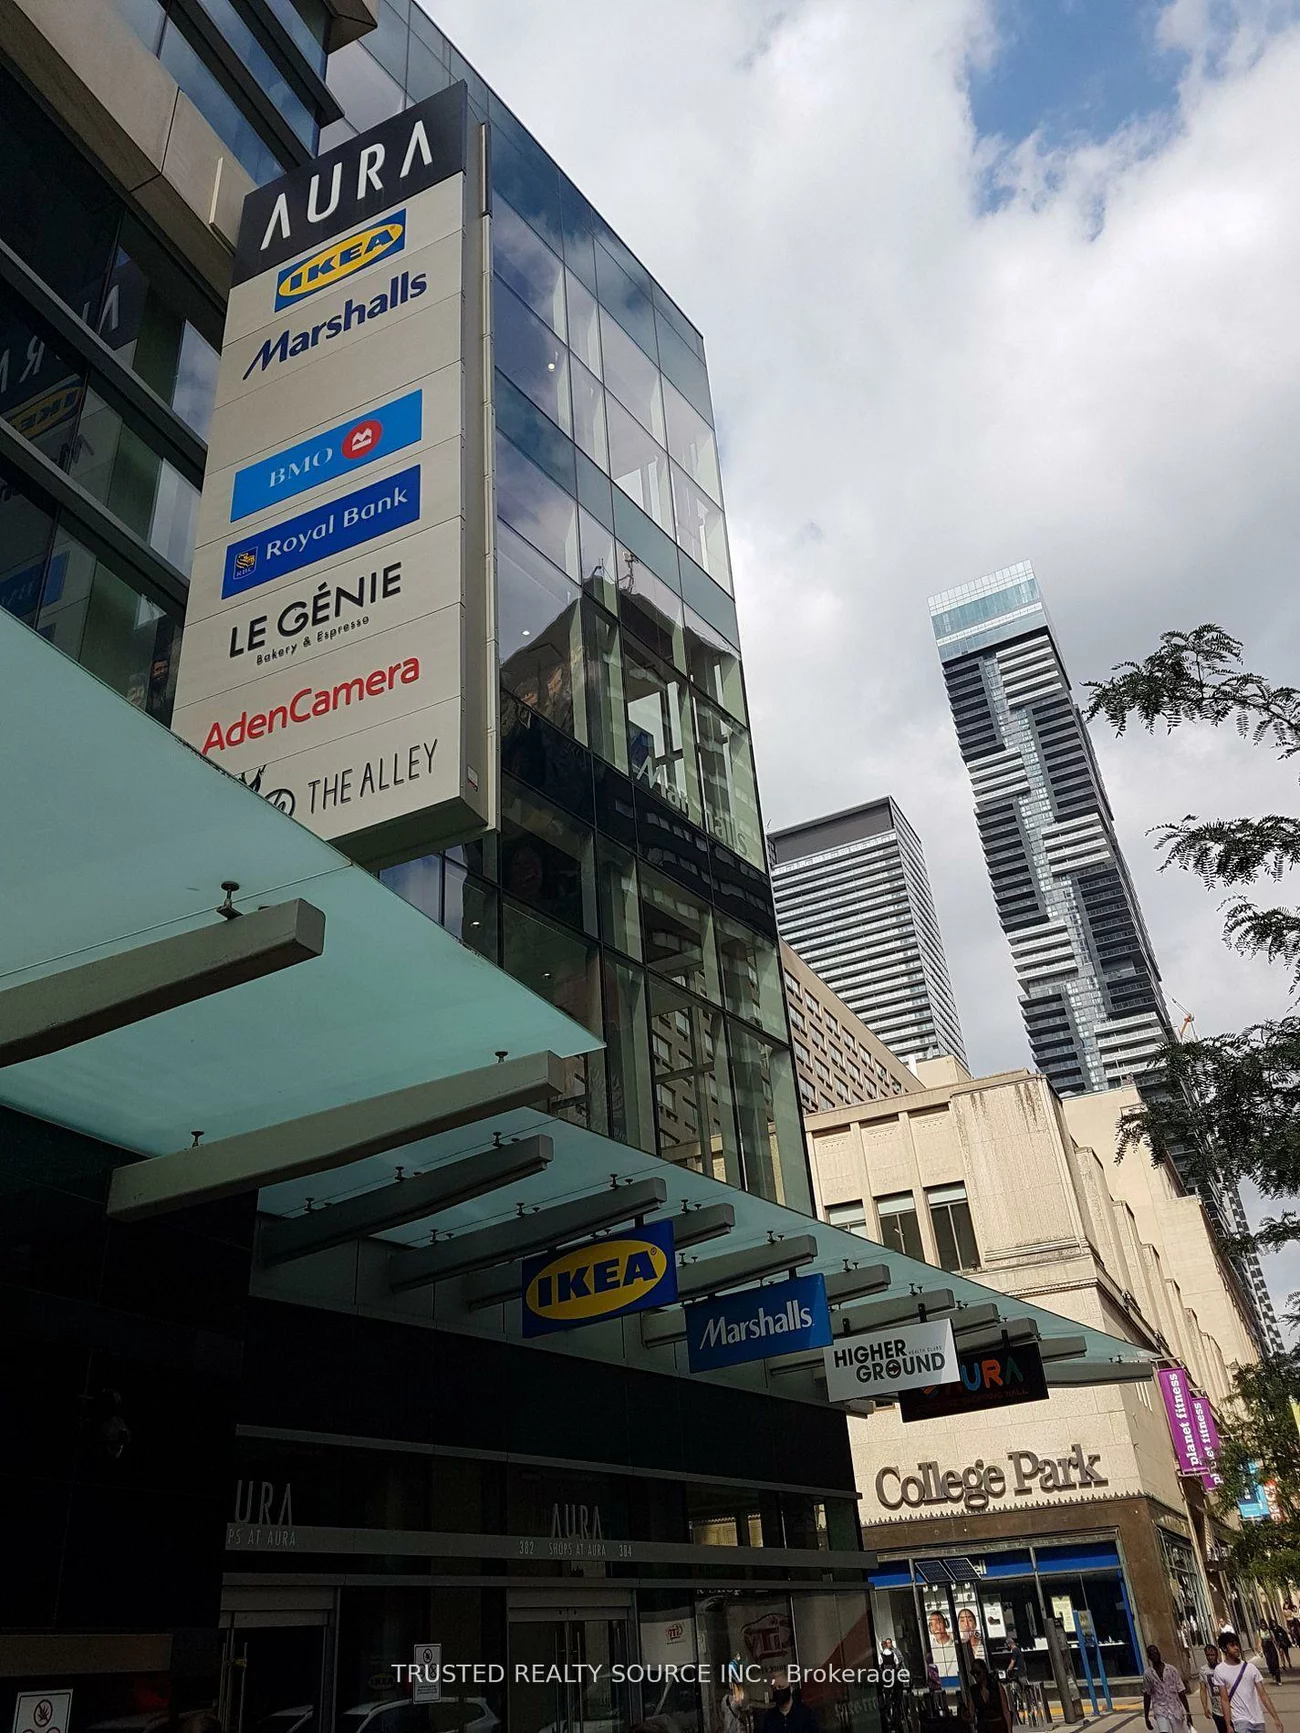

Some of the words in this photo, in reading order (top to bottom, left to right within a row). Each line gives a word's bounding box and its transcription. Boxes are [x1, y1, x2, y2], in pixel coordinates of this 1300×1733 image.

[260, 119, 433, 251] AURA
[289, 226, 395, 292] IKEA
[242, 271, 427, 381] Marshalls
[268, 447, 333, 488] BMO
[266, 517, 334, 560] Royal
[343, 487, 408, 528] Bank
[229, 615, 268, 659] LE
[277, 561, 402, 637] GÉNIE
[256, 643, 298, 666] Bakery
[303, 636, 312, 648] &
[317, 616, 370, 643] Espresso
[201, 656, 420, 755] AdenCamera
[308, 768, 354, 815] THE
[360, 738, 438, 798] ALLEY
[537, 1250, 658, 1308] IKEA
[699, 1300, 813, 1350] Marshalls
[834, 1339, 907, 1368] HIGHER
[856, 1352, 946, 1383] GROUND
[1169, 1373, 1188, 1419] fitness
[1179, 1421, 1202, 1467] planet
[1194, 1402, 1211, 1444] fitness
[876, 1459, 1006, 1510] College
[1007, 1443, 1109, 1497] Park
[234, 1479, 292, 1526] URA
[551, 1503, 603, 1541] AURA
[227, 1528, 241, 1545] PS
[247, 1529, 261, 1545] AT
[267, 1530, 297, 1547] AURA
[519, 1541, 535, 1555] 382
[548, 1542, 573, 1556] SHOPS
[576, 1543, 584, 1556] AT
[588, 1544, 607, 1557] AURA
[618, 1544, 633, 1558] 384
[973, 1559, 987, 1575] ell
